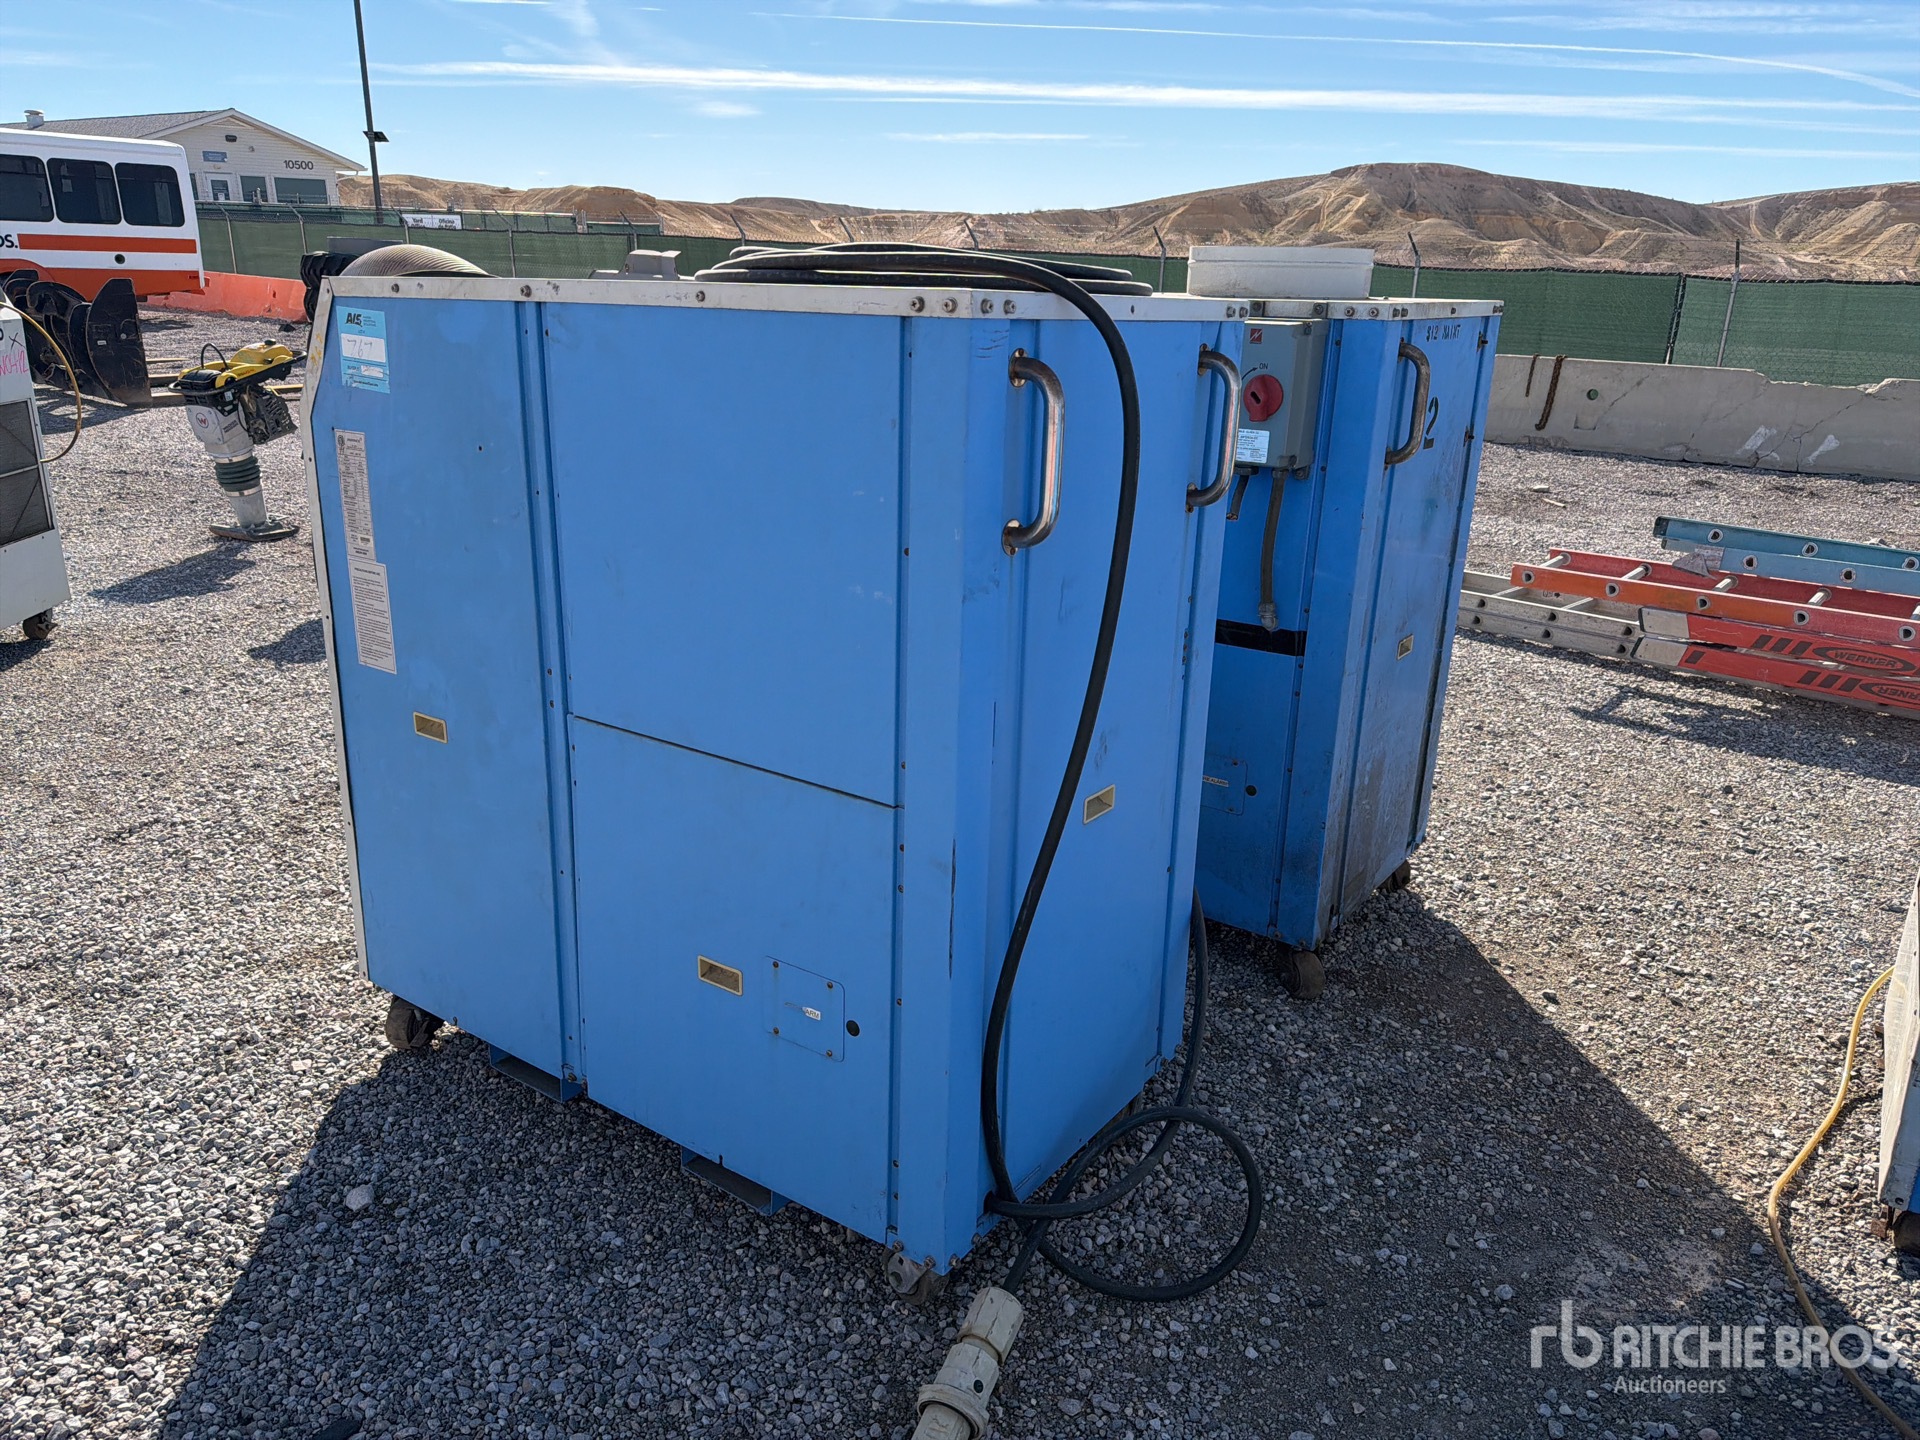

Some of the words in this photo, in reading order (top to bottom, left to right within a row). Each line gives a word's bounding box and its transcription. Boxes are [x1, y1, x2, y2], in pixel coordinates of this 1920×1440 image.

[283, 160, 314, 170] 10500
[345, 312, 362, 327] AIS
[1423, 396, 1439, 449] 2
[1835, 651, 1897, 667] WERNER
[1878, 686, 1920, 700] RNER
